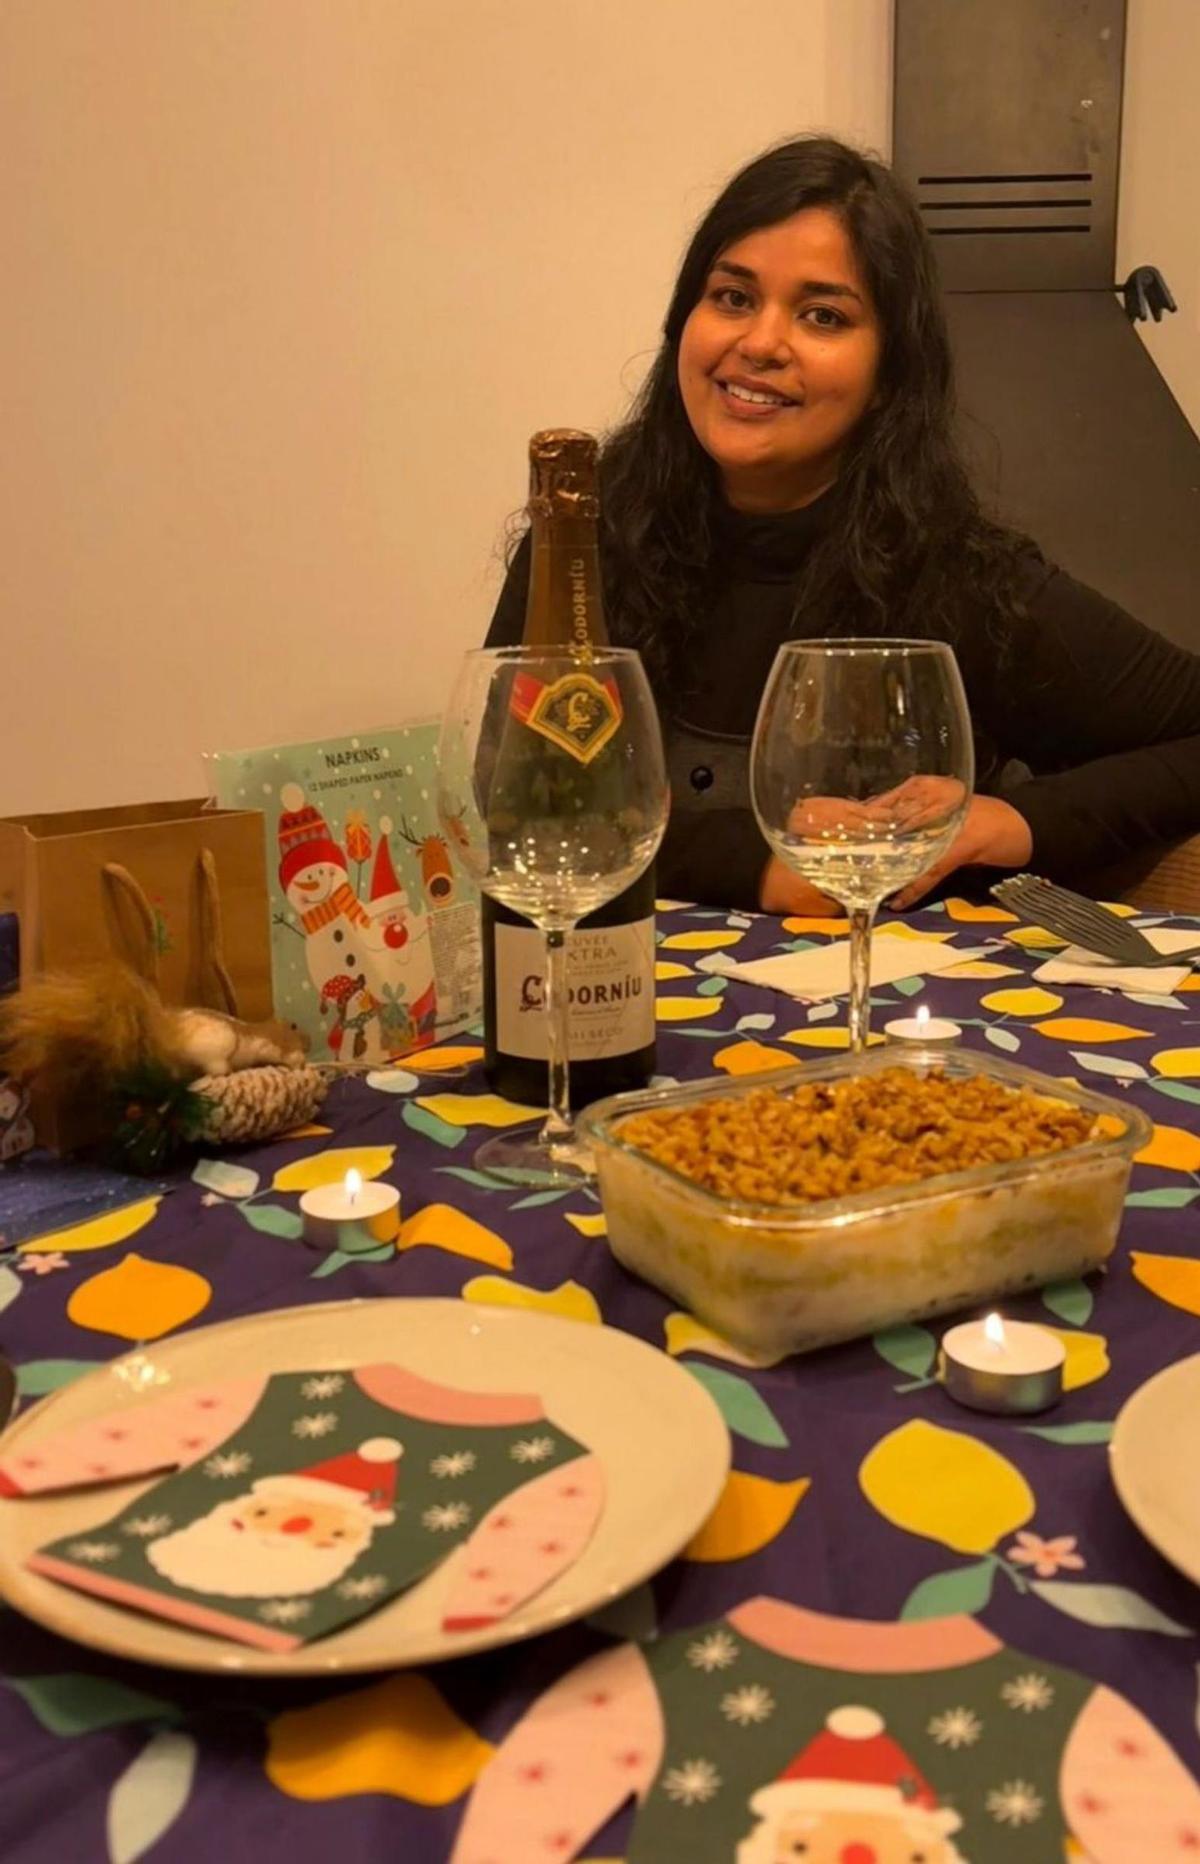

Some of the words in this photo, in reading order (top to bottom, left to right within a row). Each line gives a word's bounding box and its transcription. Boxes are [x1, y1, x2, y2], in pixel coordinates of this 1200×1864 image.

[325, 747, 381, 768] NAPKINS
[350, 774, 373, 785] PAPER
[373, 768, 404, 781] NAPKINS
